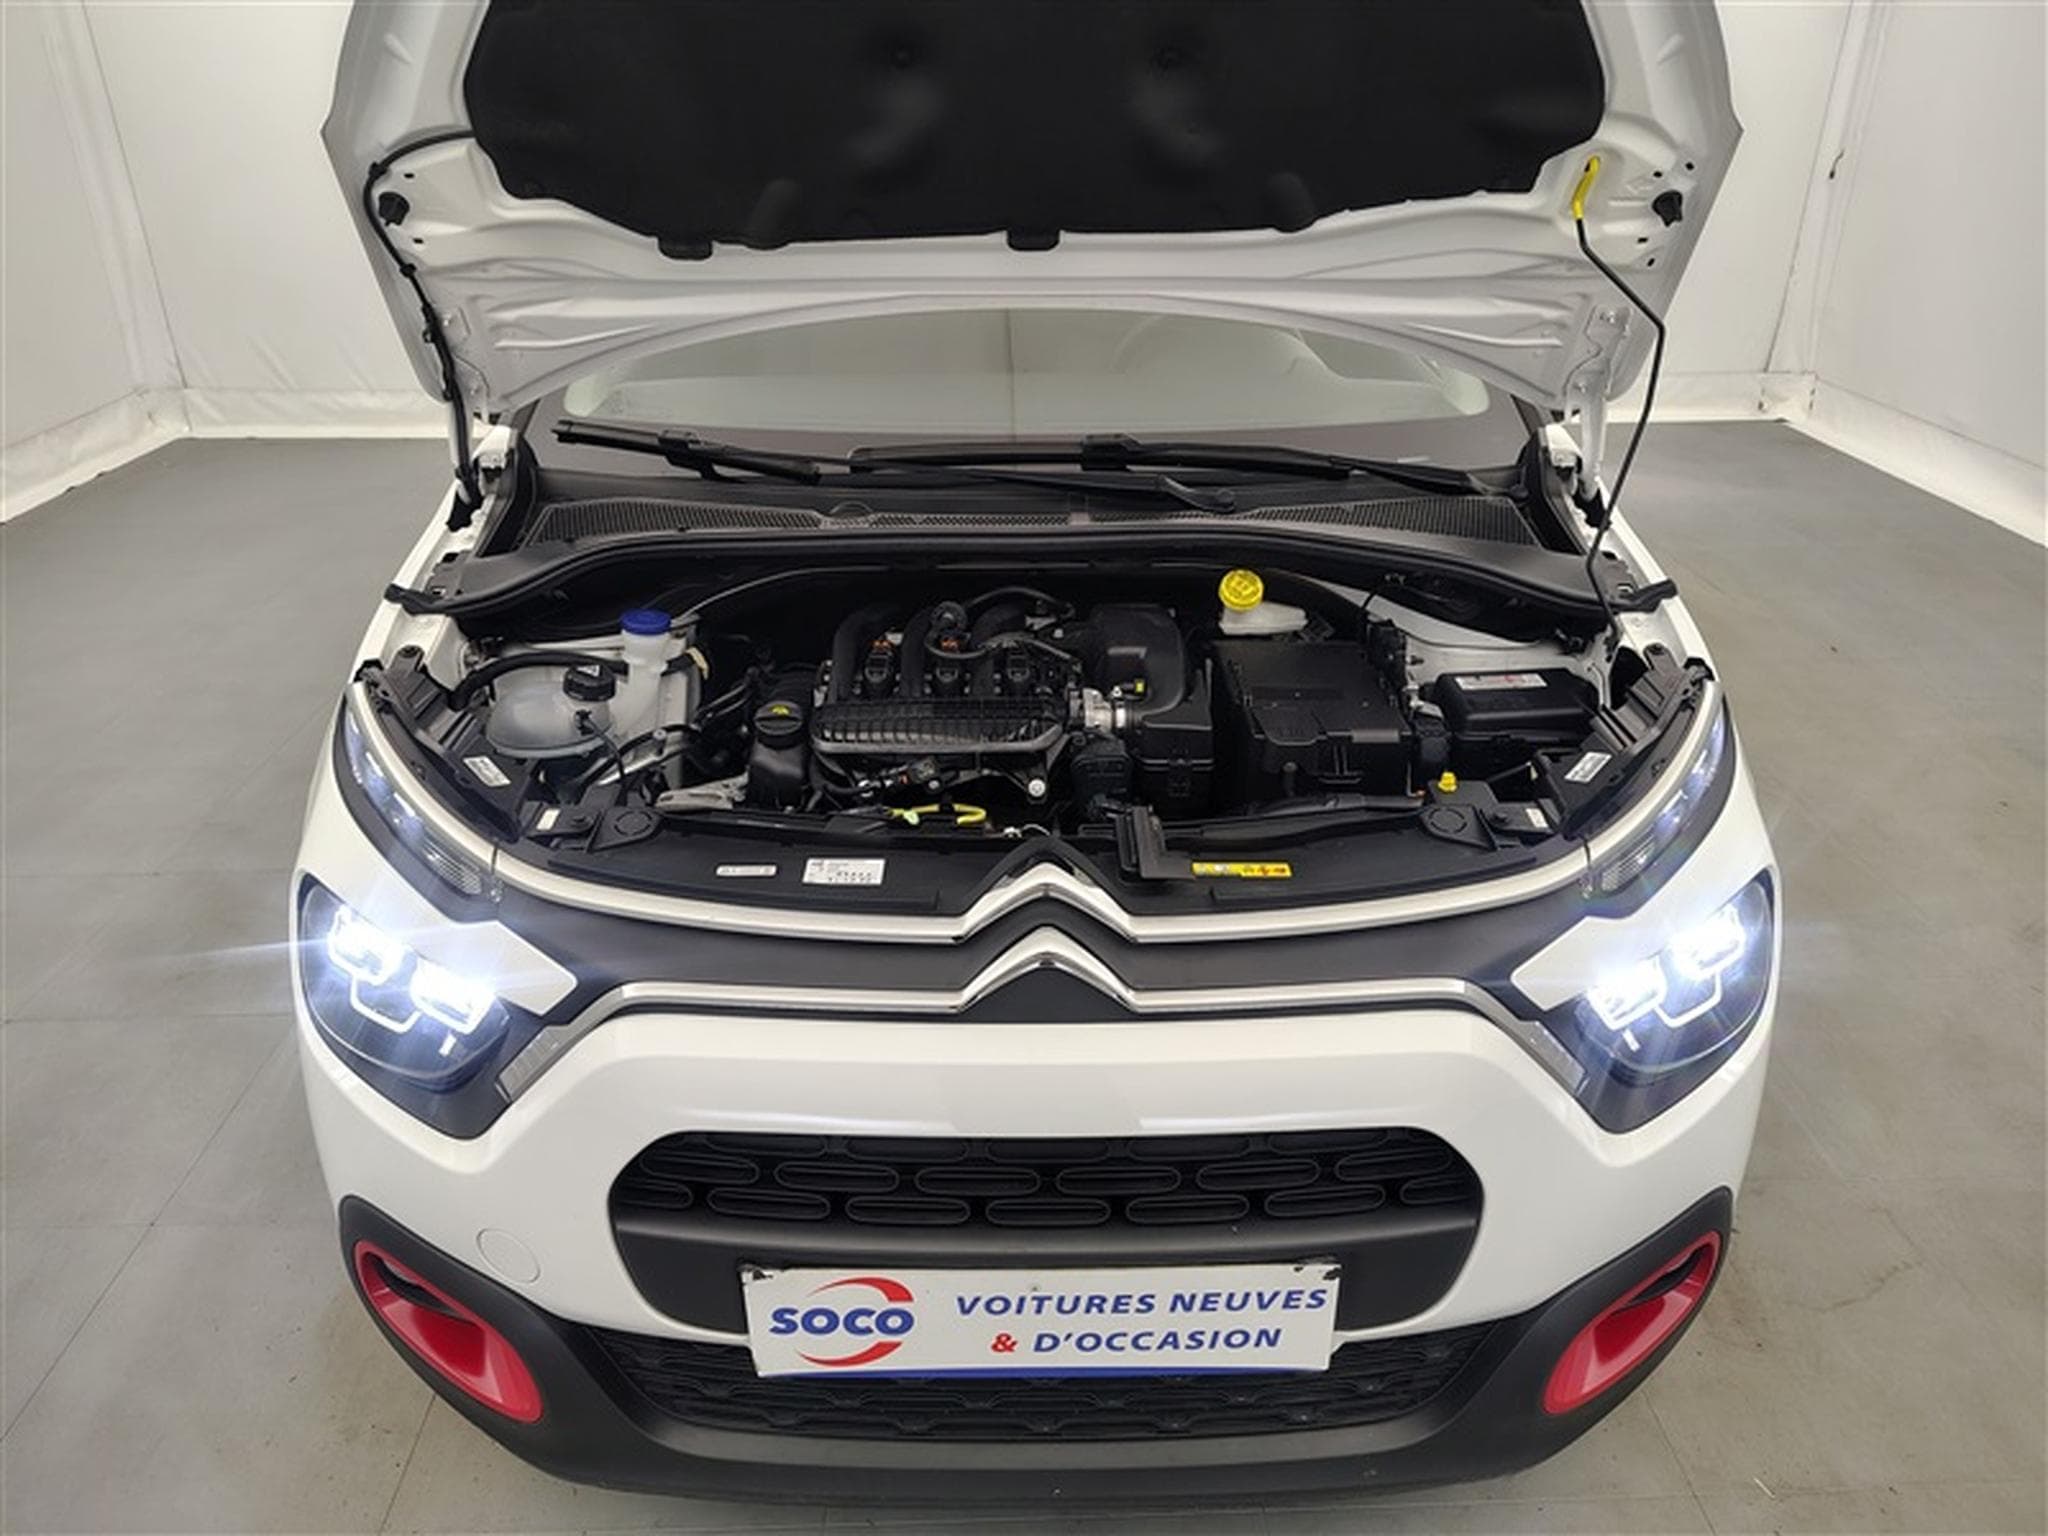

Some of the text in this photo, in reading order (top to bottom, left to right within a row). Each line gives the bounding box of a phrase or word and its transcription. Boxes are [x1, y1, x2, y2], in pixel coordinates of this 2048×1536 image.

[956, 1289, 1327, 1316] VOITURES NEUVES
[769, 1307, 914, 1337] SOCO
[991, 1328, 1282, 1354] & D'OCCASION
